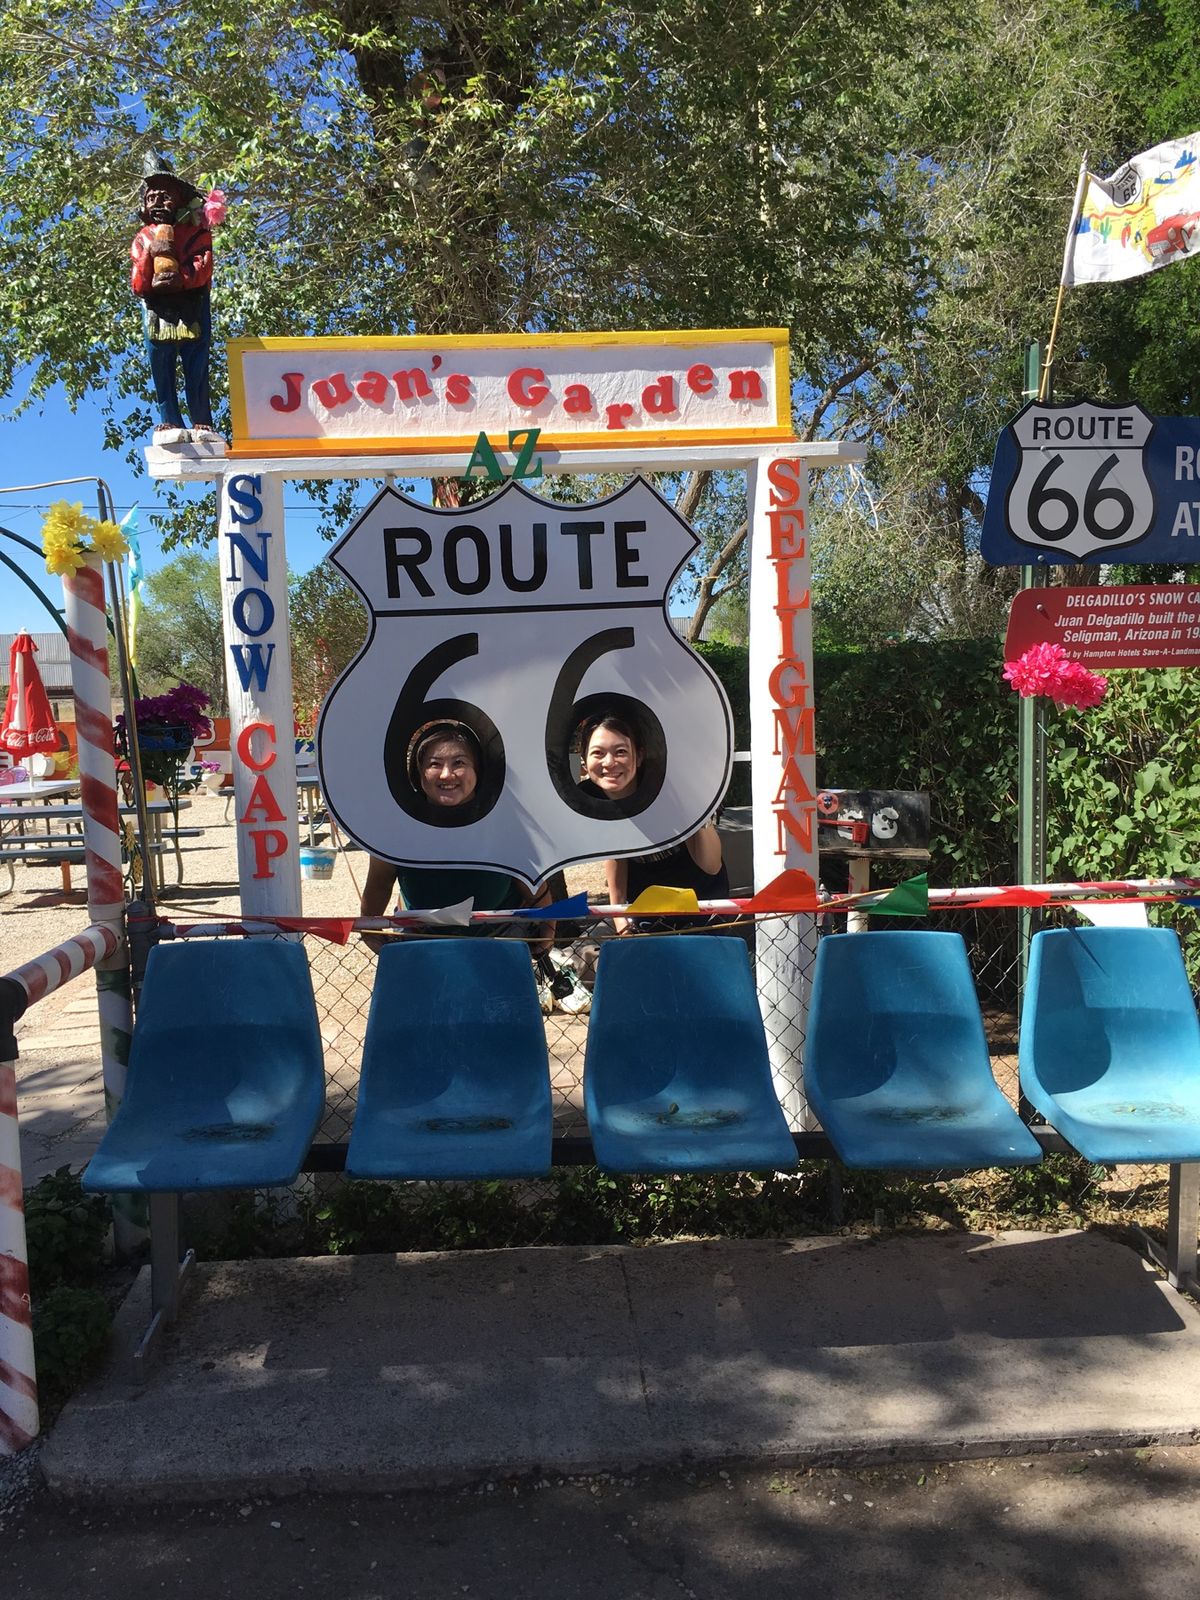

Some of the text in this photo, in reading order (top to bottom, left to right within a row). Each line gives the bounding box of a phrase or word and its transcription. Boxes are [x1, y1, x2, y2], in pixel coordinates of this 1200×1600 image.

[269, 355, 764, 431] Juan's Garden
[459, 427, 543, 481] AZ
[1032, 416, 1134, 440] ROUTE
[1175, 446, 1200, 481] R
[1027, 453, 1135, 541] 66
[224, 473, 276, 693] SNOW
[383, 521, 649, 598] ROUTE
[1054, 611, 1195, 628] Juan Delgadillo built the
[1066, 592, 1146, 607] DELGADILLO'S
[1149, 592, 1184, 605] SNOW
[765, 459, 816, 856] SELIGMAN
[1063, 626, 1200, 644] Seligman, Arizona in 19
[1072, 650, 1081, 659] by
[1084, 649, 1116, 658] Hampton
[1118, 648, 1140, 657] Hotels
[383, 626, 668, 829] 66
[237, 722, 289, 881] CAP
